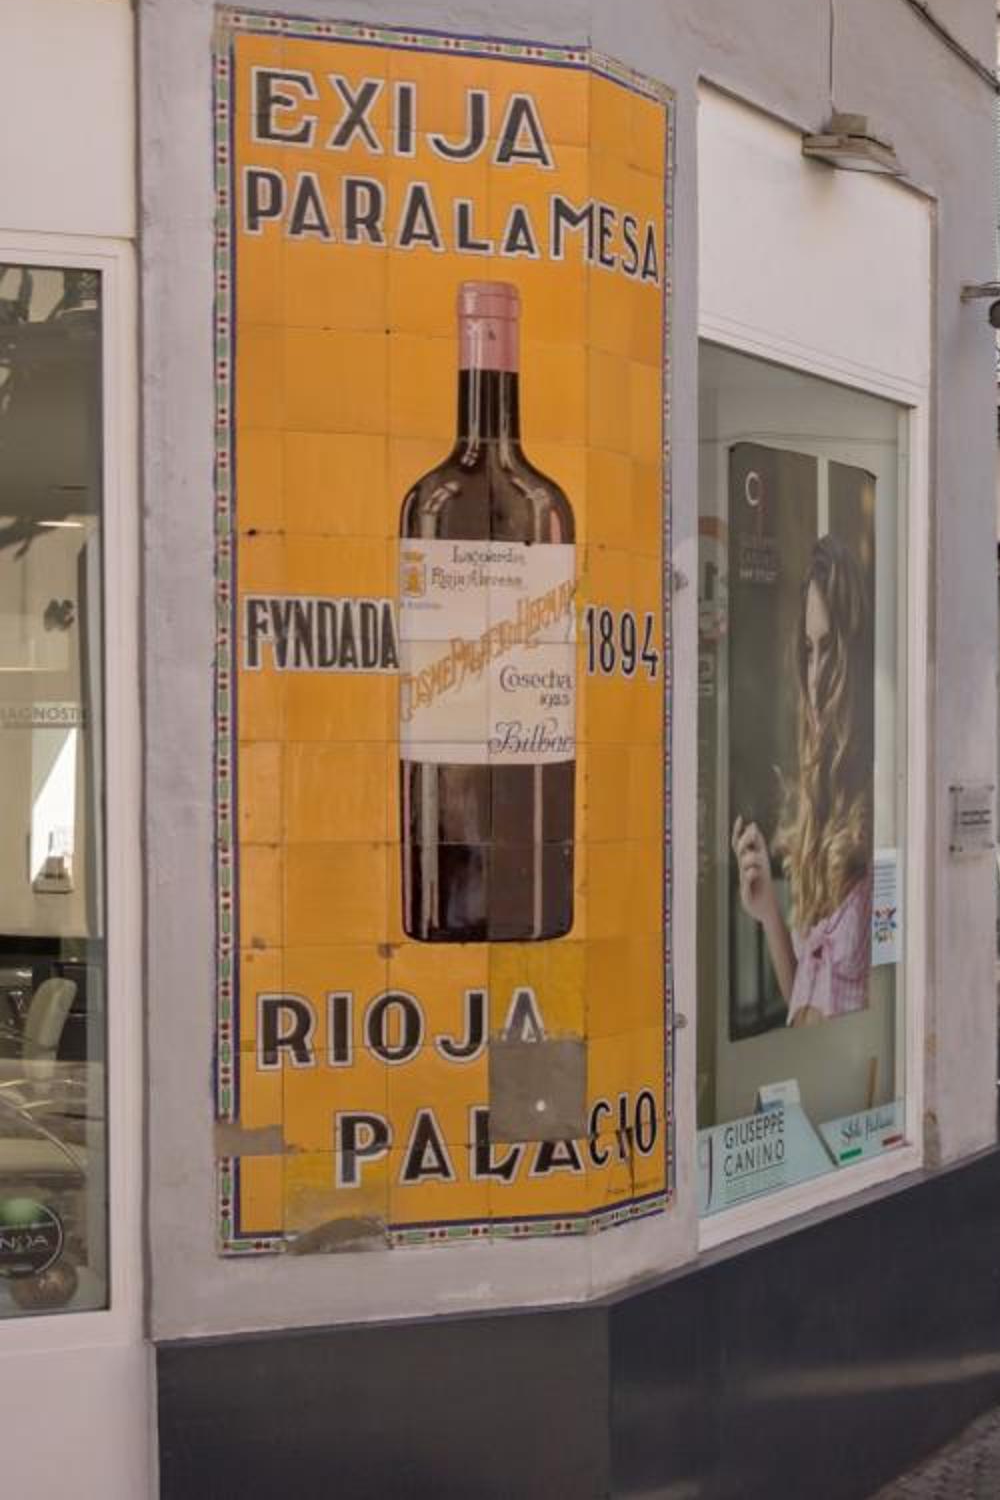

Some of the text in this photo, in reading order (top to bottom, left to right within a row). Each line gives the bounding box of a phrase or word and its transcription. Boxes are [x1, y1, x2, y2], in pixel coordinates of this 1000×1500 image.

[251, 67, 556, 169] EXIJA
[550, 196, 662, 288] MESA
[244, 596, 399, 671] FVNDADA
[583, 605, 661, 678] 1894
[500, 664, 573, 692] Cosecha
[256, 986, 550, 1070] RIOJA
[723, 1110, 785, 1150] GIUSEPPE
[723, 1139, 785, 1177] CANINO
